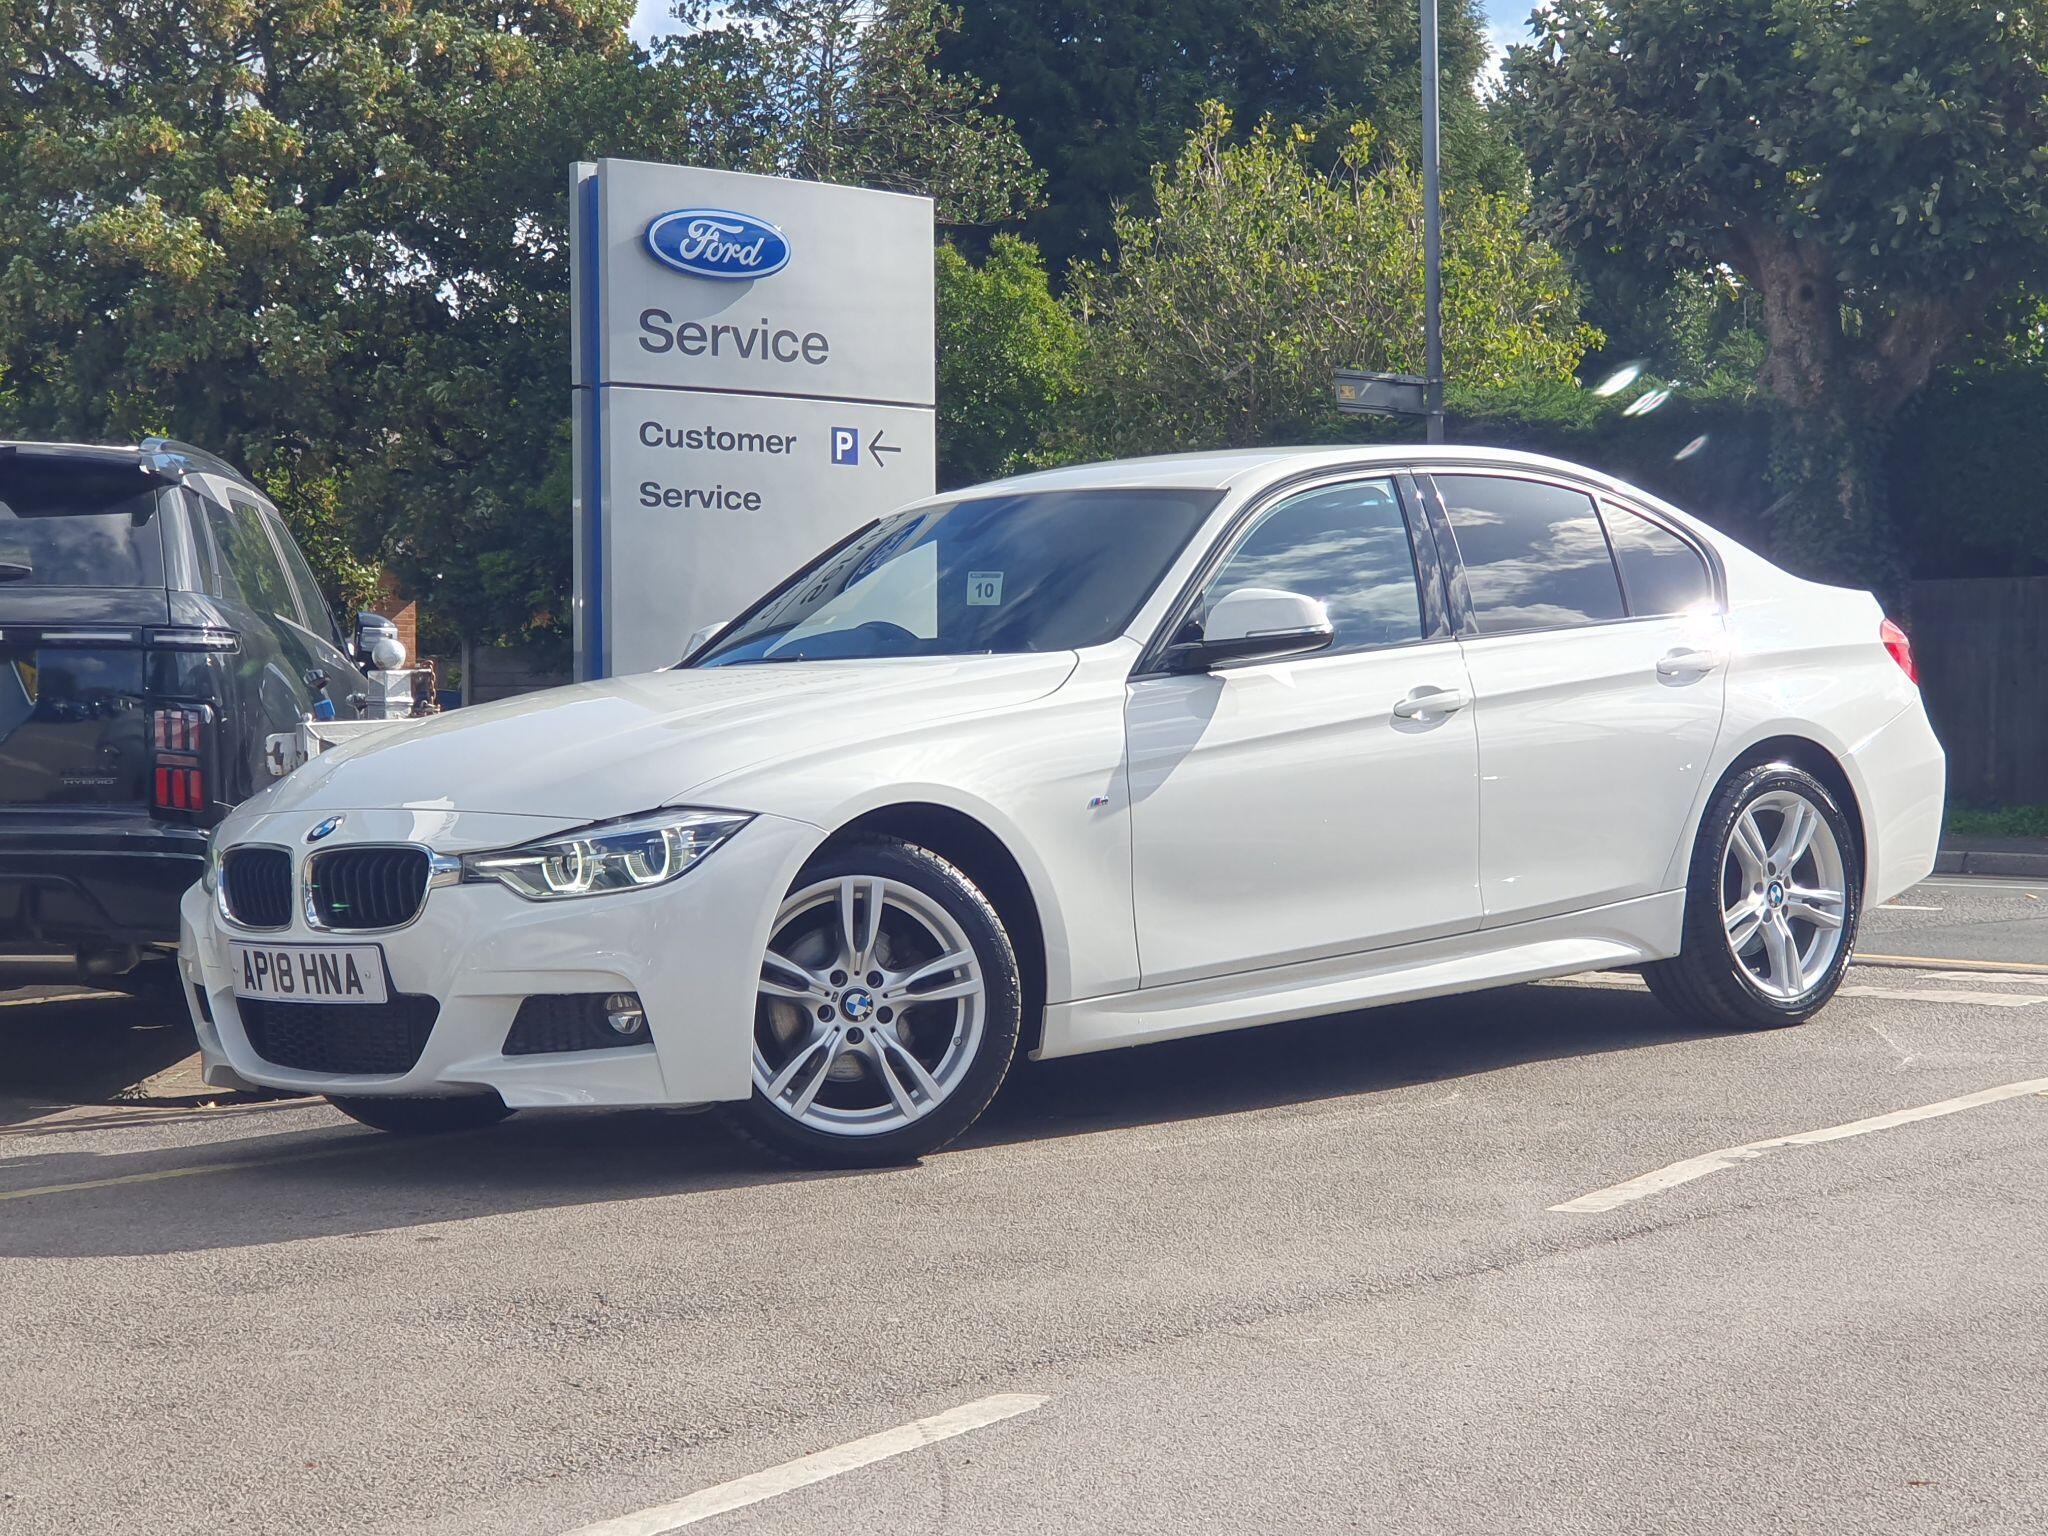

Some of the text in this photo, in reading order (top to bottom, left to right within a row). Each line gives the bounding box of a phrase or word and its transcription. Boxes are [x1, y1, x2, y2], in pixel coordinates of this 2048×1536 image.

[679, 219, 765, 267] Ford
[638, 308, 829, 366] Service
[638, 421, 853, 461] Customer P
[638, 481, 762, 512] Service
[975, 582, 994, 598] 10
[242, 949, 364, 995] AP18 HNA
